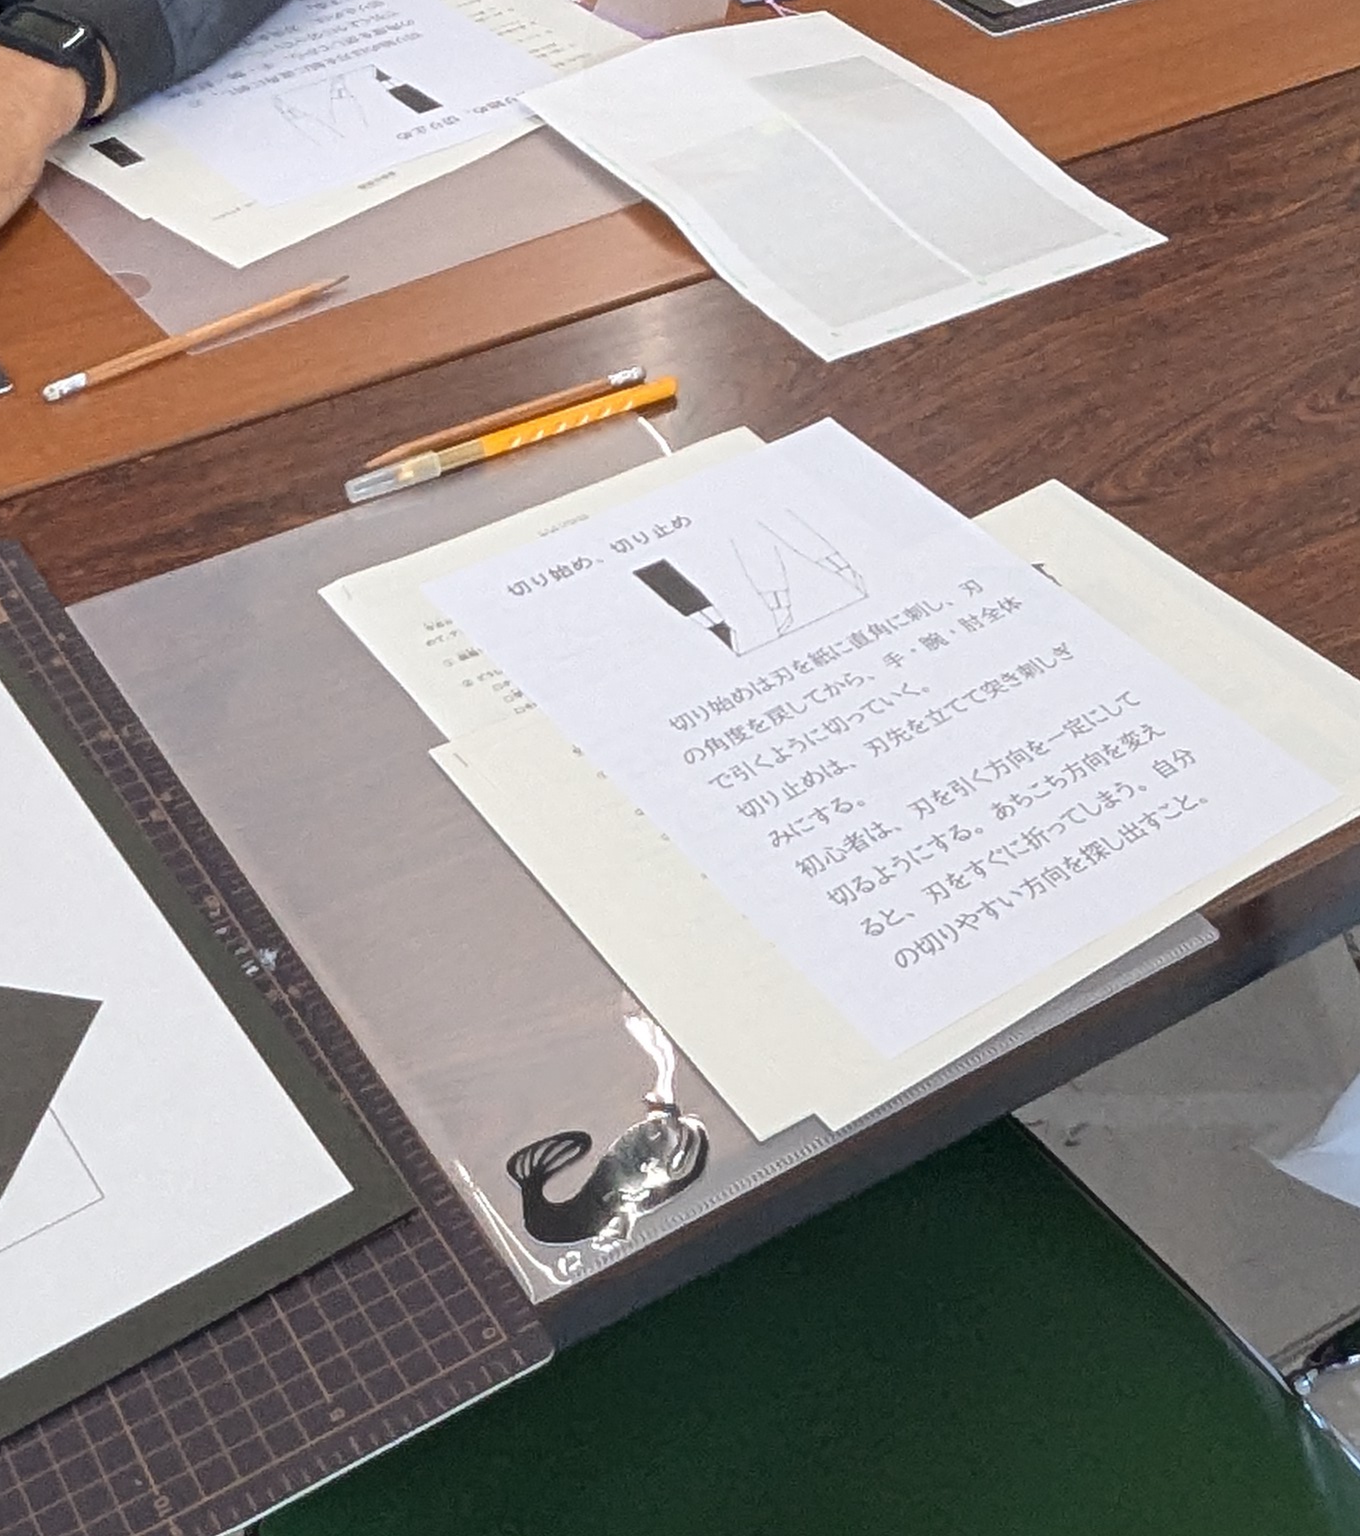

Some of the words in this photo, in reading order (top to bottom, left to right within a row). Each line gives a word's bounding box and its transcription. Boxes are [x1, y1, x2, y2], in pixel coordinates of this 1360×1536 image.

[506, 514, 692, 596] 切り始め、切り止め
[706, 681, 930, 789] で引くように切っていく。
[767, 796, 866, 848] みにする。
[825, 722, 1166, 907] 切るようにする。あちこち方向を変え
